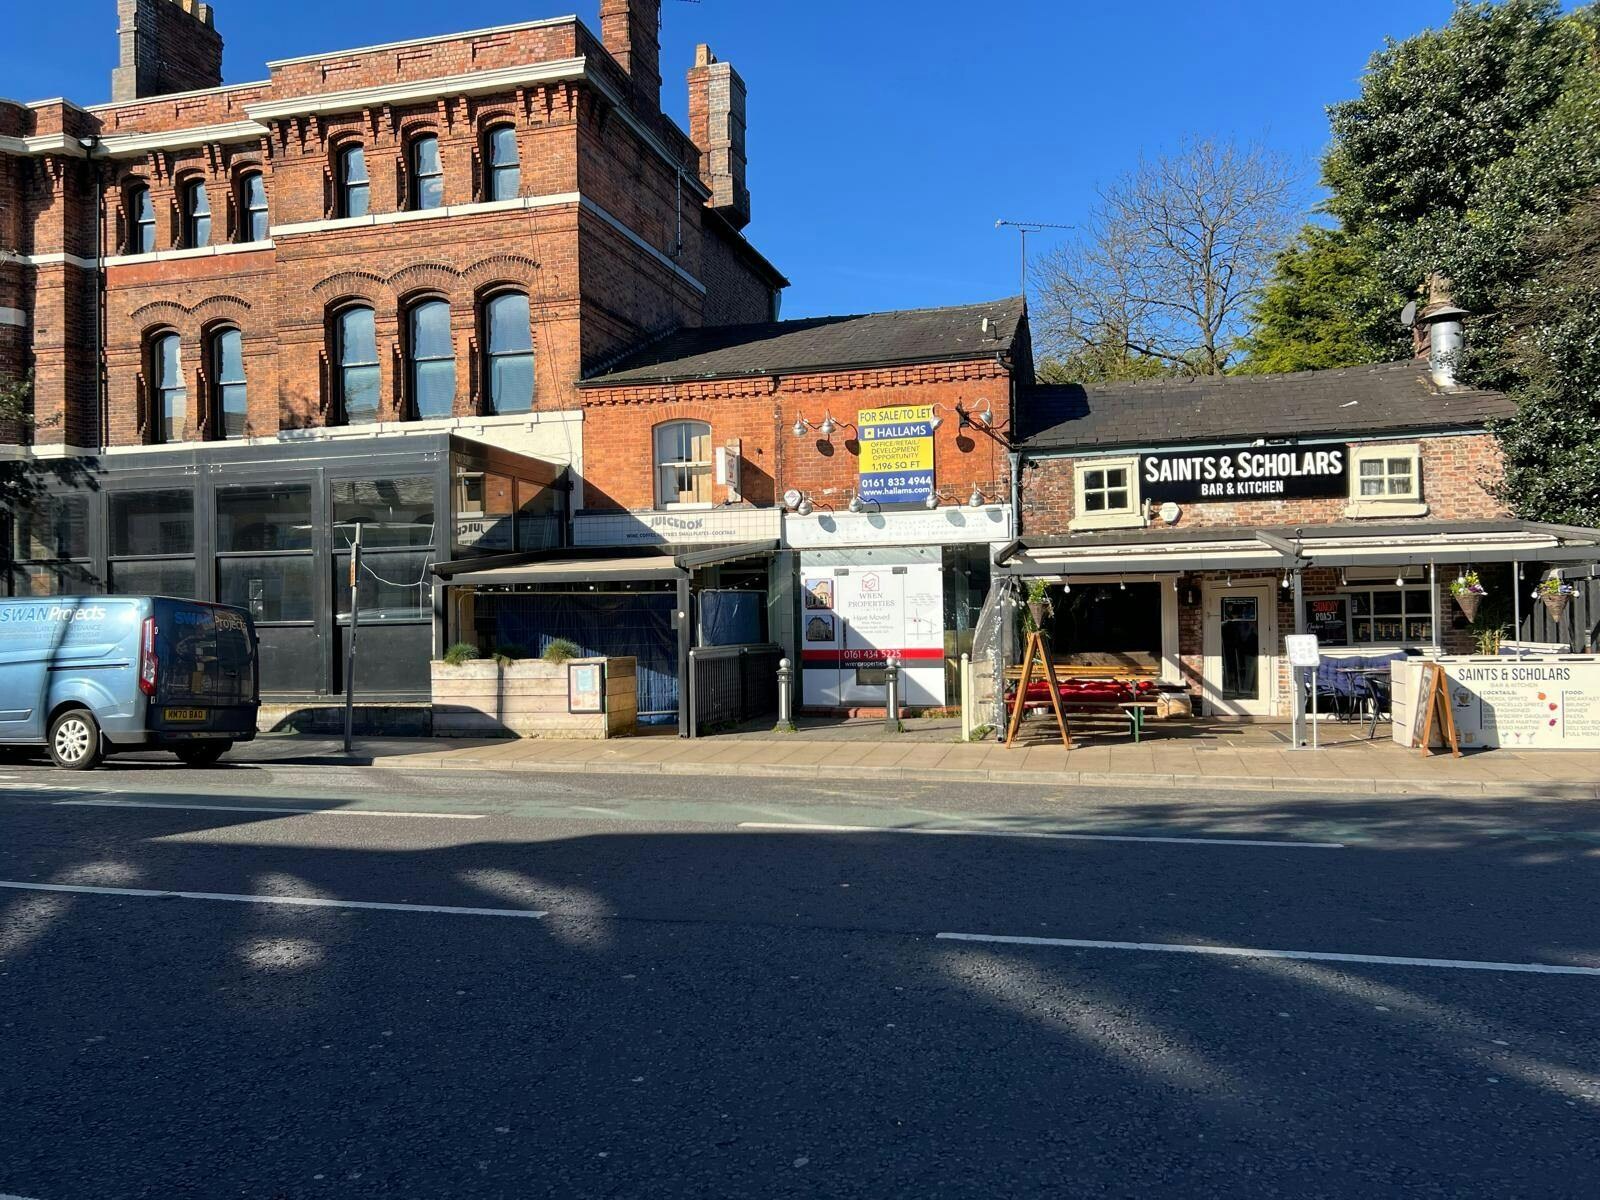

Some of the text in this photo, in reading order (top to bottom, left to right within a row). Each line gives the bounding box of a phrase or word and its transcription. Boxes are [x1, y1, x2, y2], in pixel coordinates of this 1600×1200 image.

[860, 408, 931, 422] FOR SALE/TO LET
[878, 425, 926, 438] HALLAMS
[872, 446, 920, 454] DEVELOPMENT
[872, 452, 918, 460] OPPORTUNITY
[872, 462, 892, 470] 1,196
[1145, 451, 1343, 482] SAINTS & SCHOLARS
[862, 476, 932, 488] 0161 833 4944
[1201, 480, 1284, 496] BAR & KITCHEN
[863, 486, 930, 496] www.hallams.com
[650, 516, 703, 530] JUICEBOX
[844, 649, 902, 658] 0161 434 5225
[1458, 668, 1570, 680] SAINTS & SCHOLARS
